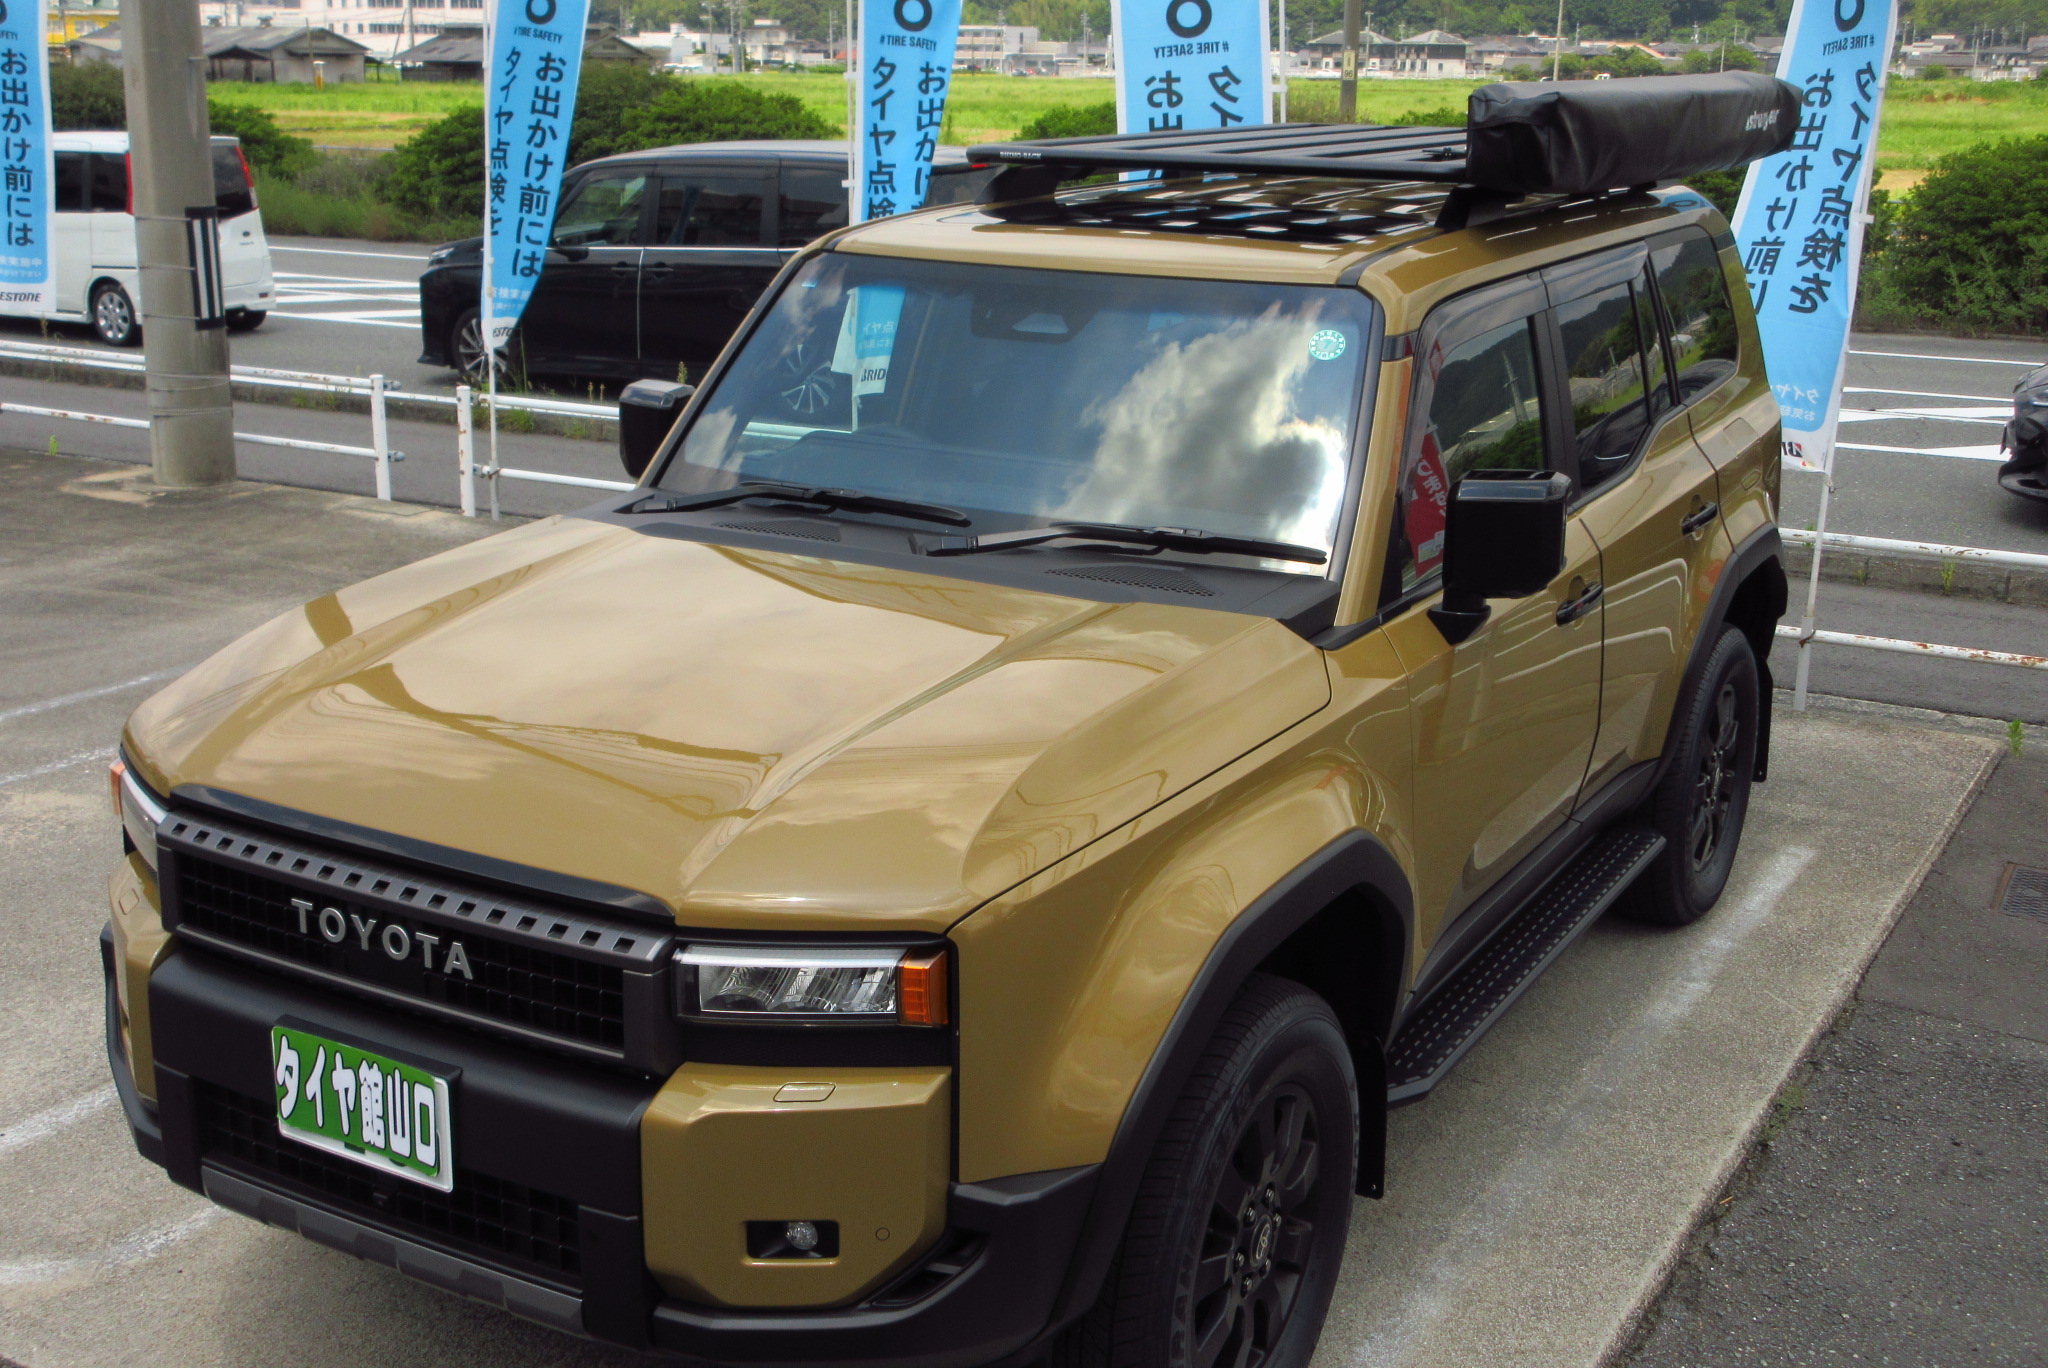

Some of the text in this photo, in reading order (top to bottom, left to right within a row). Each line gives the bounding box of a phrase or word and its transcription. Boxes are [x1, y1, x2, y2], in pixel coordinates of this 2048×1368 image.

[533, 28, 563, 44] SAFETY
[909, 36, 937, 52] SAFETY
[0, 48, 34, 247] お出かけ前には
[512, 51, 568, 278] お出かけ前には
[291, 897, 474, 981] TOYOTA
[275, 1033, 437, 1169] タイヤ館山口
